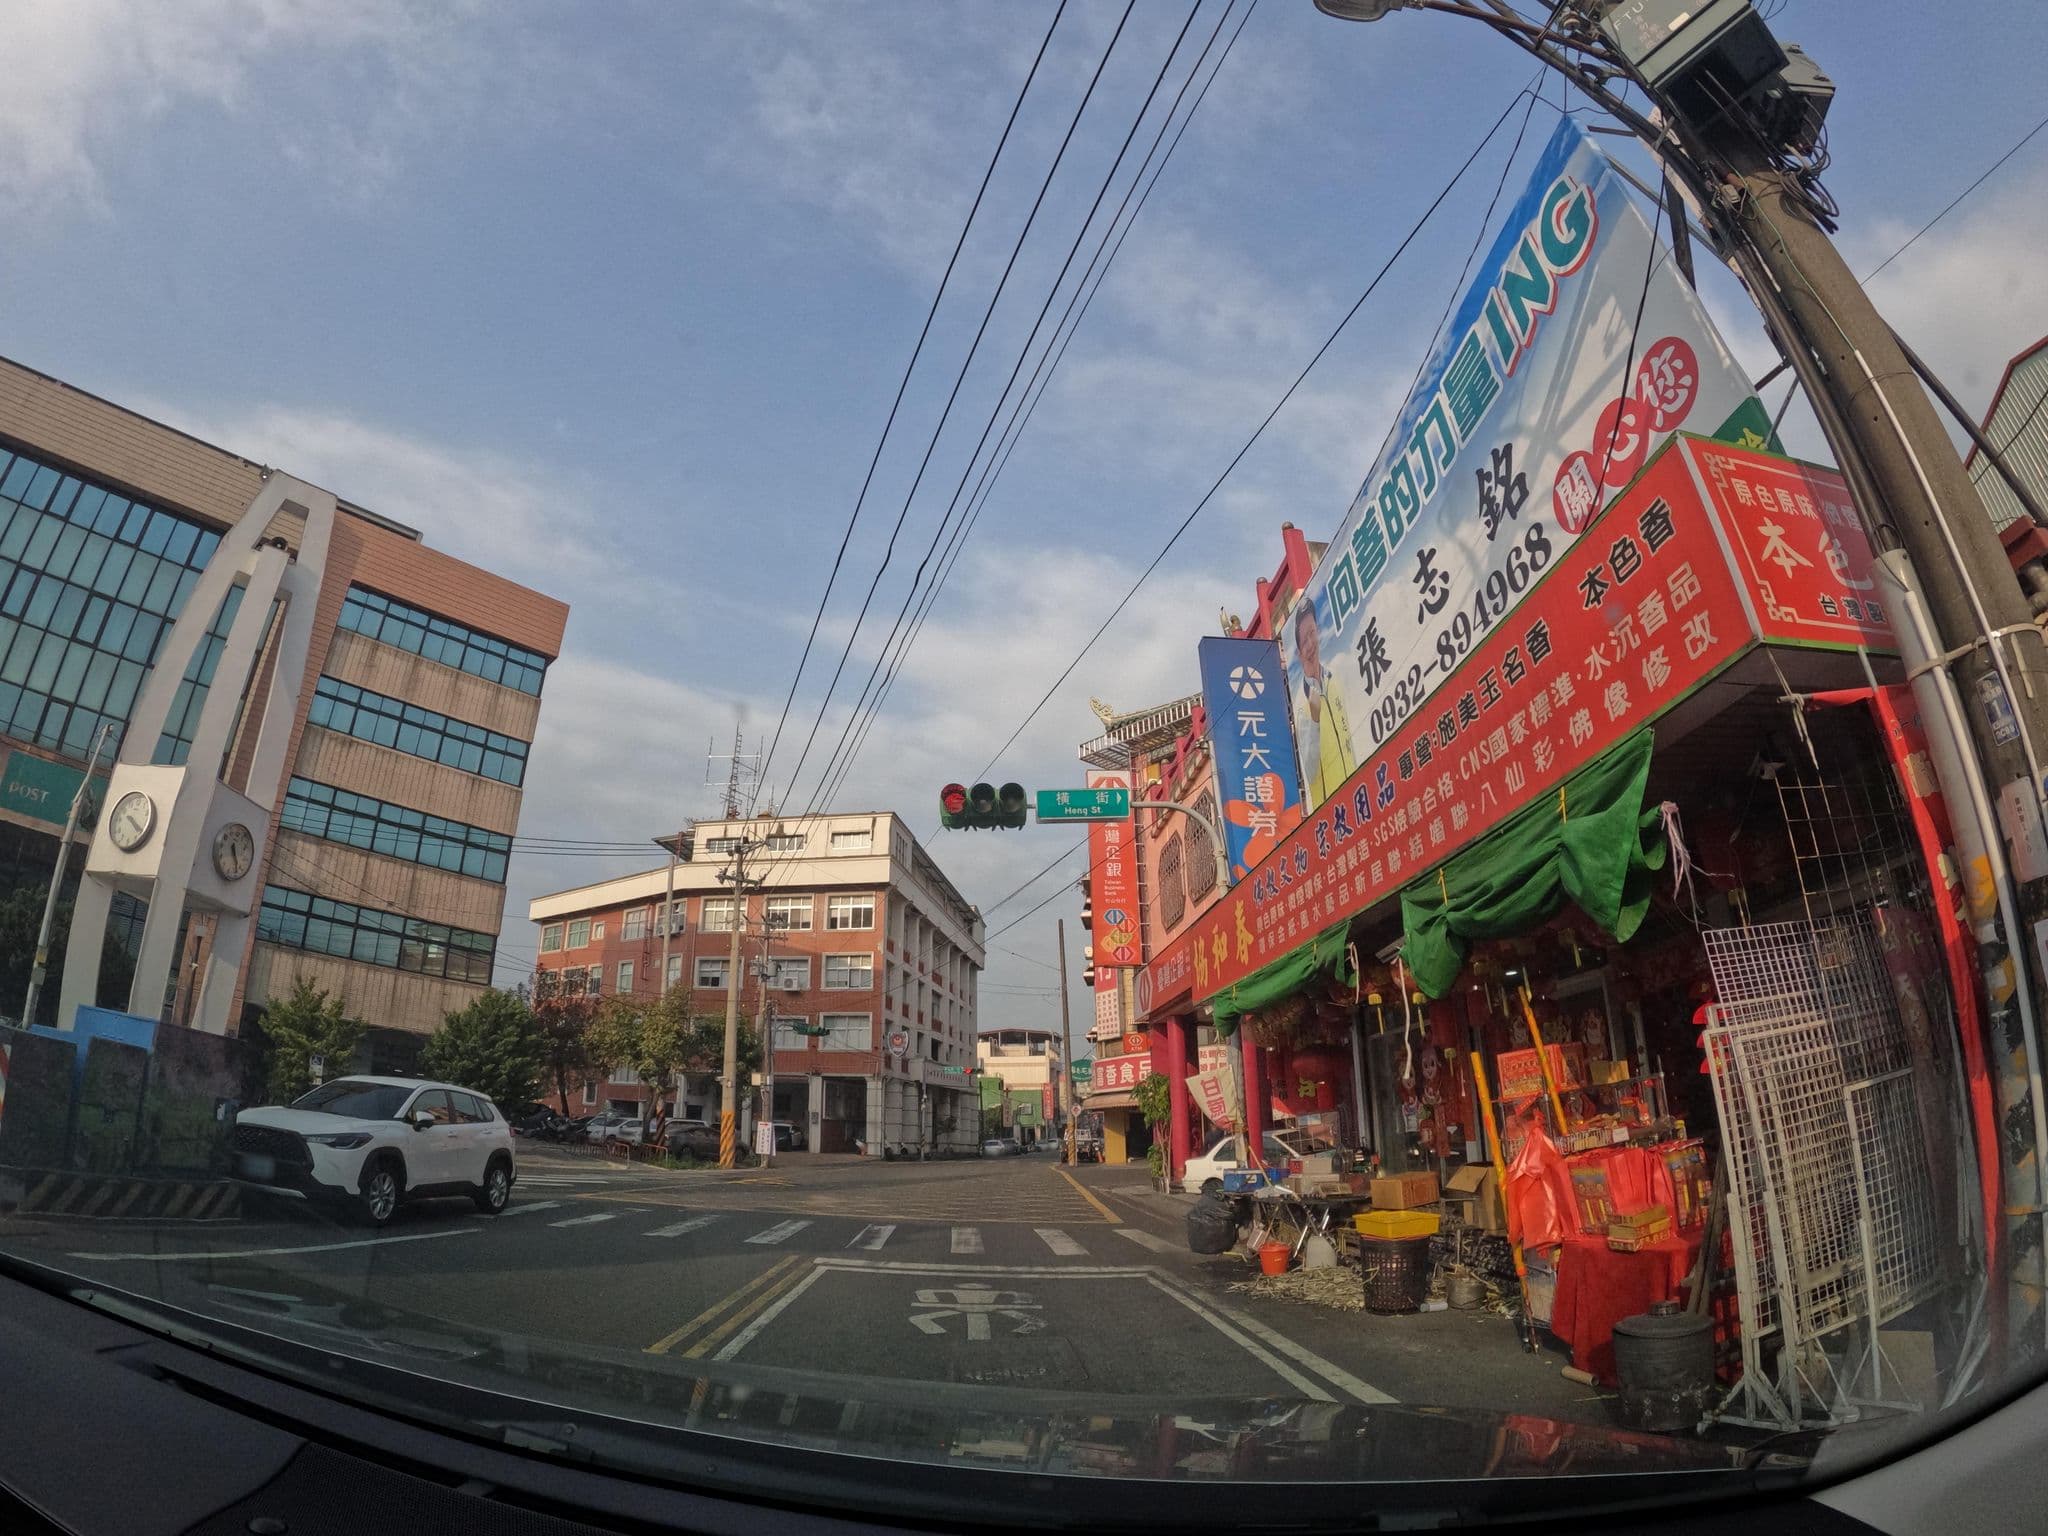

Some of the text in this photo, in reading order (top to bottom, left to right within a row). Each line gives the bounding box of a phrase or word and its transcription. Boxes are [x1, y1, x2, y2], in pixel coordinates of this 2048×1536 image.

[1555, 346, 1693, 530] 關心您
[1357, 443, 1530, 696] 張志銘
[1370, 522, 1552, 744] 0932-894968
[1315, 761, 1396, 859] 宗教用品
[1578, 495, 1676, 609] 本色香
[9, 781, 50, 803] POST
[1064, 806, 1088, 816] Heng
[1237, 711, 1277, 837] 元大證券
